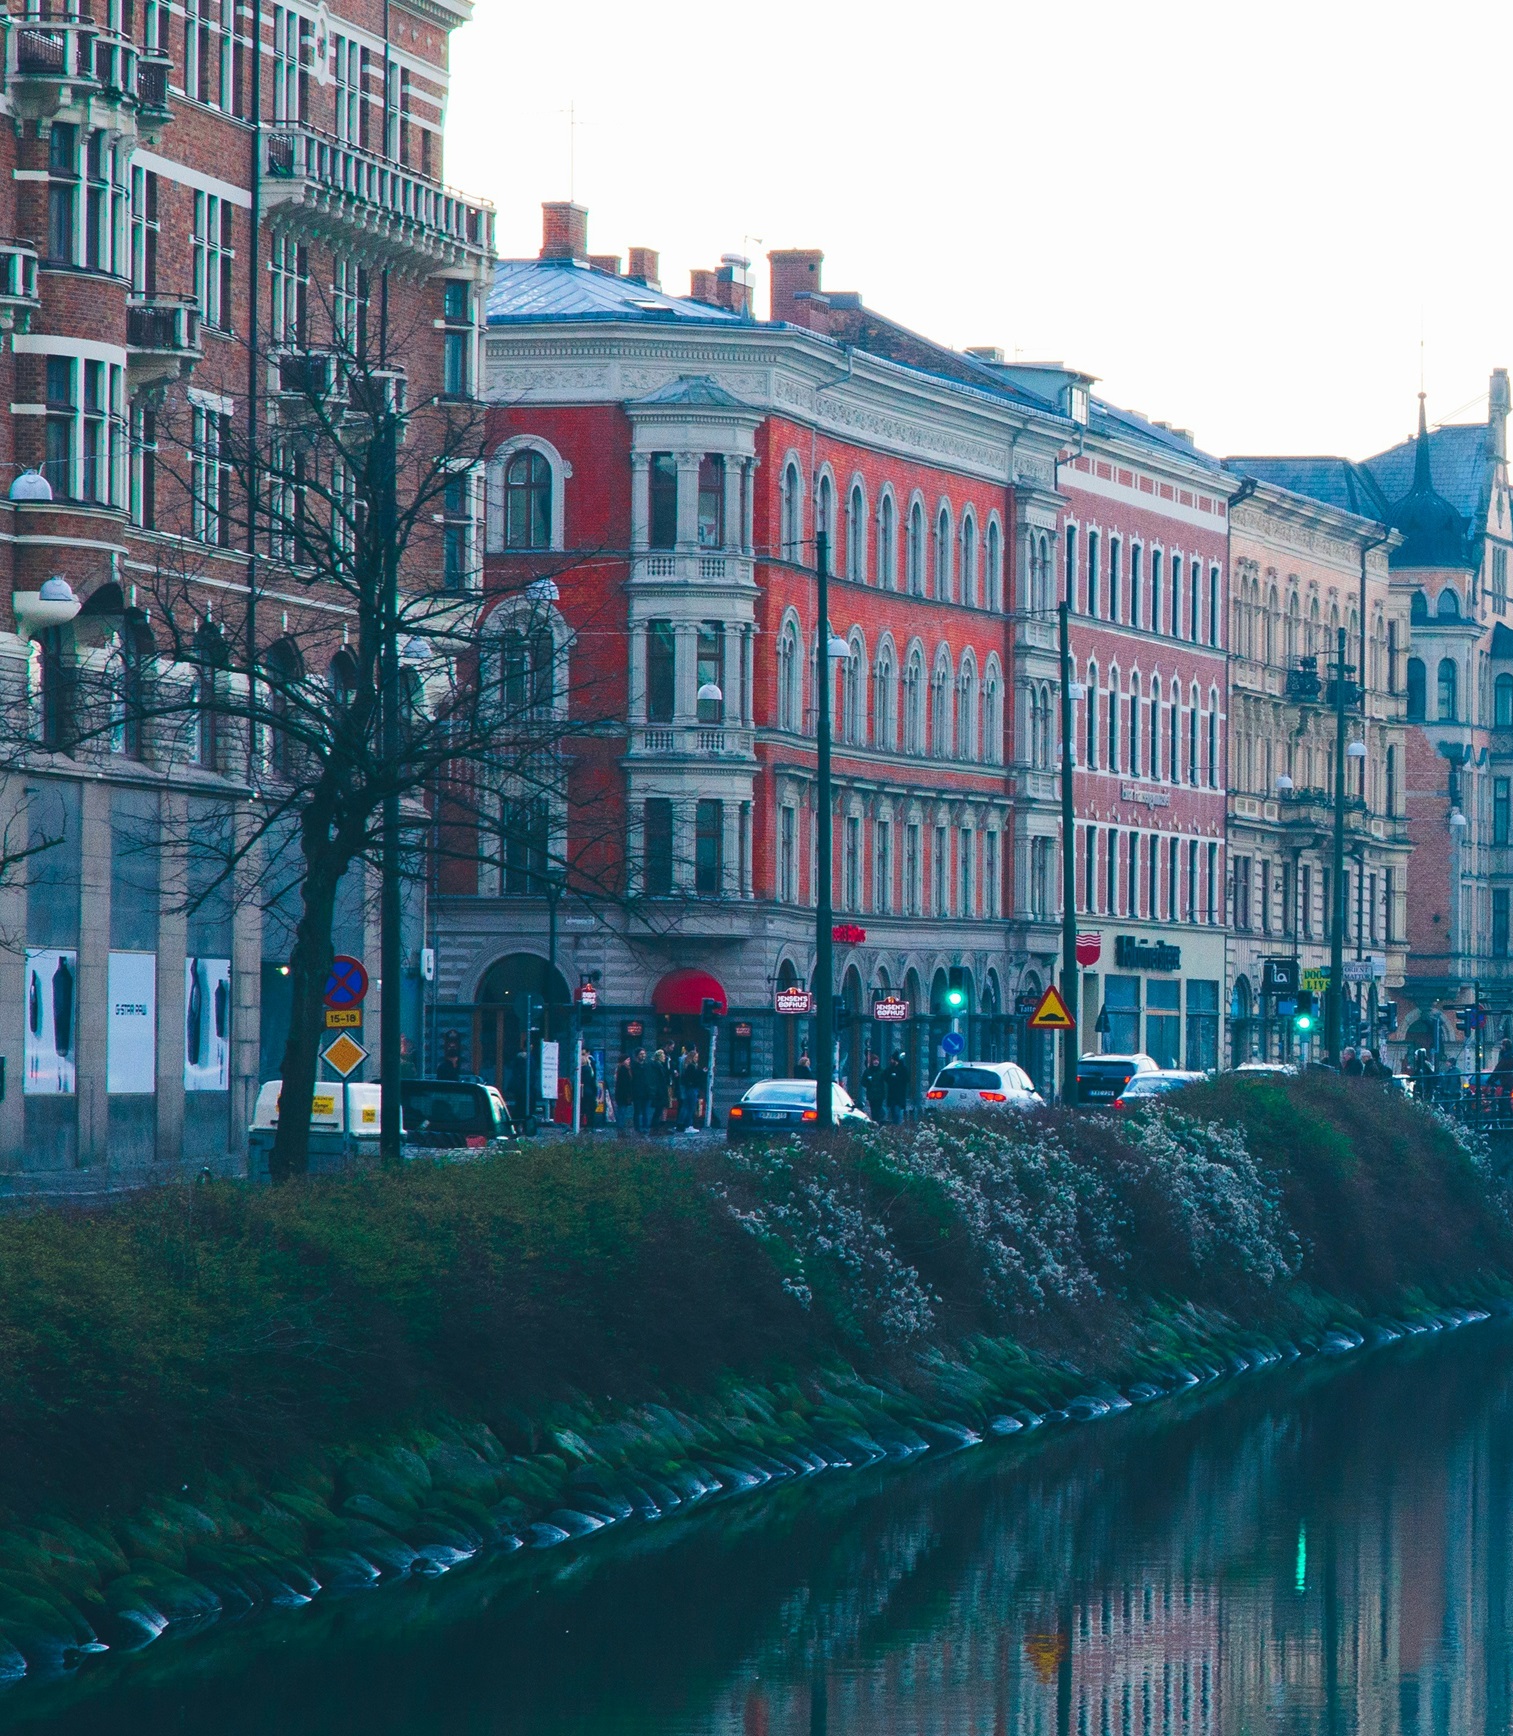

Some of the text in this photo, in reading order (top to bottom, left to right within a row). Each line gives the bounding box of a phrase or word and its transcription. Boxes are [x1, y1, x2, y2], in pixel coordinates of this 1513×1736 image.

[115, 1004, 147, 1015] G-STAR RAW
[330, 1013, 357, 1023] 15-18
